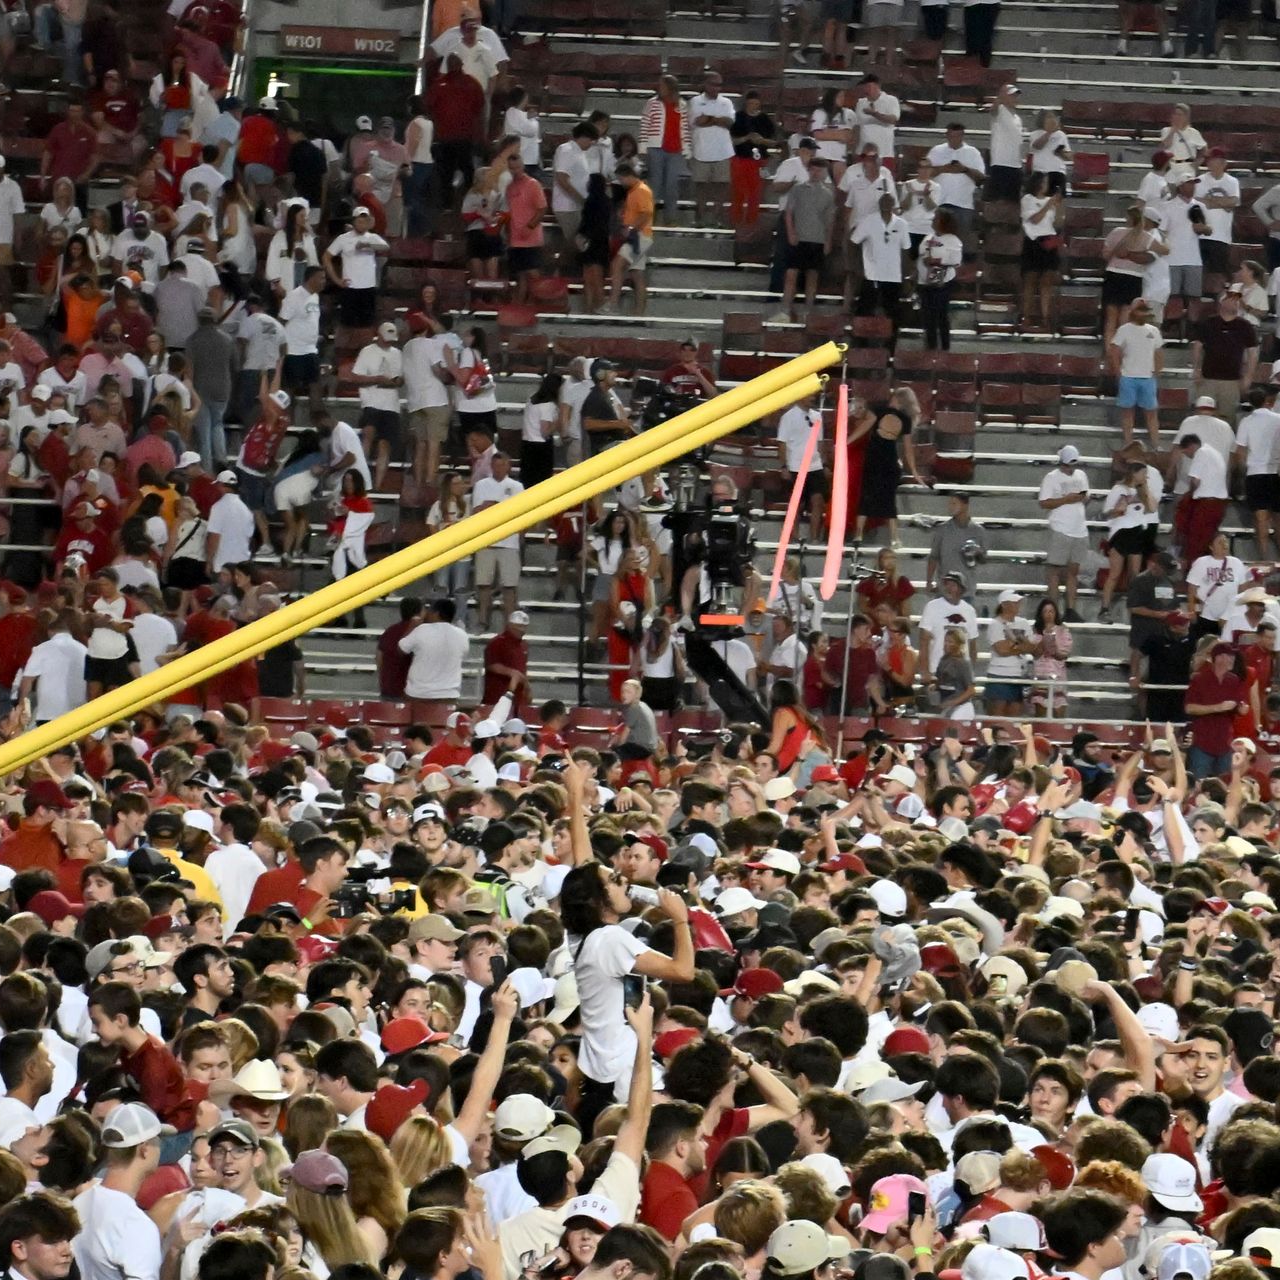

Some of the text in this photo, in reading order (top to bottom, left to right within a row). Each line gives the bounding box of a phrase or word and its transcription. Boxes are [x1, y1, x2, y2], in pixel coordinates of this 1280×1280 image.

[285, 36, 396, 53] W101 W102
[1206, 567, 1234, 582] HOGS
